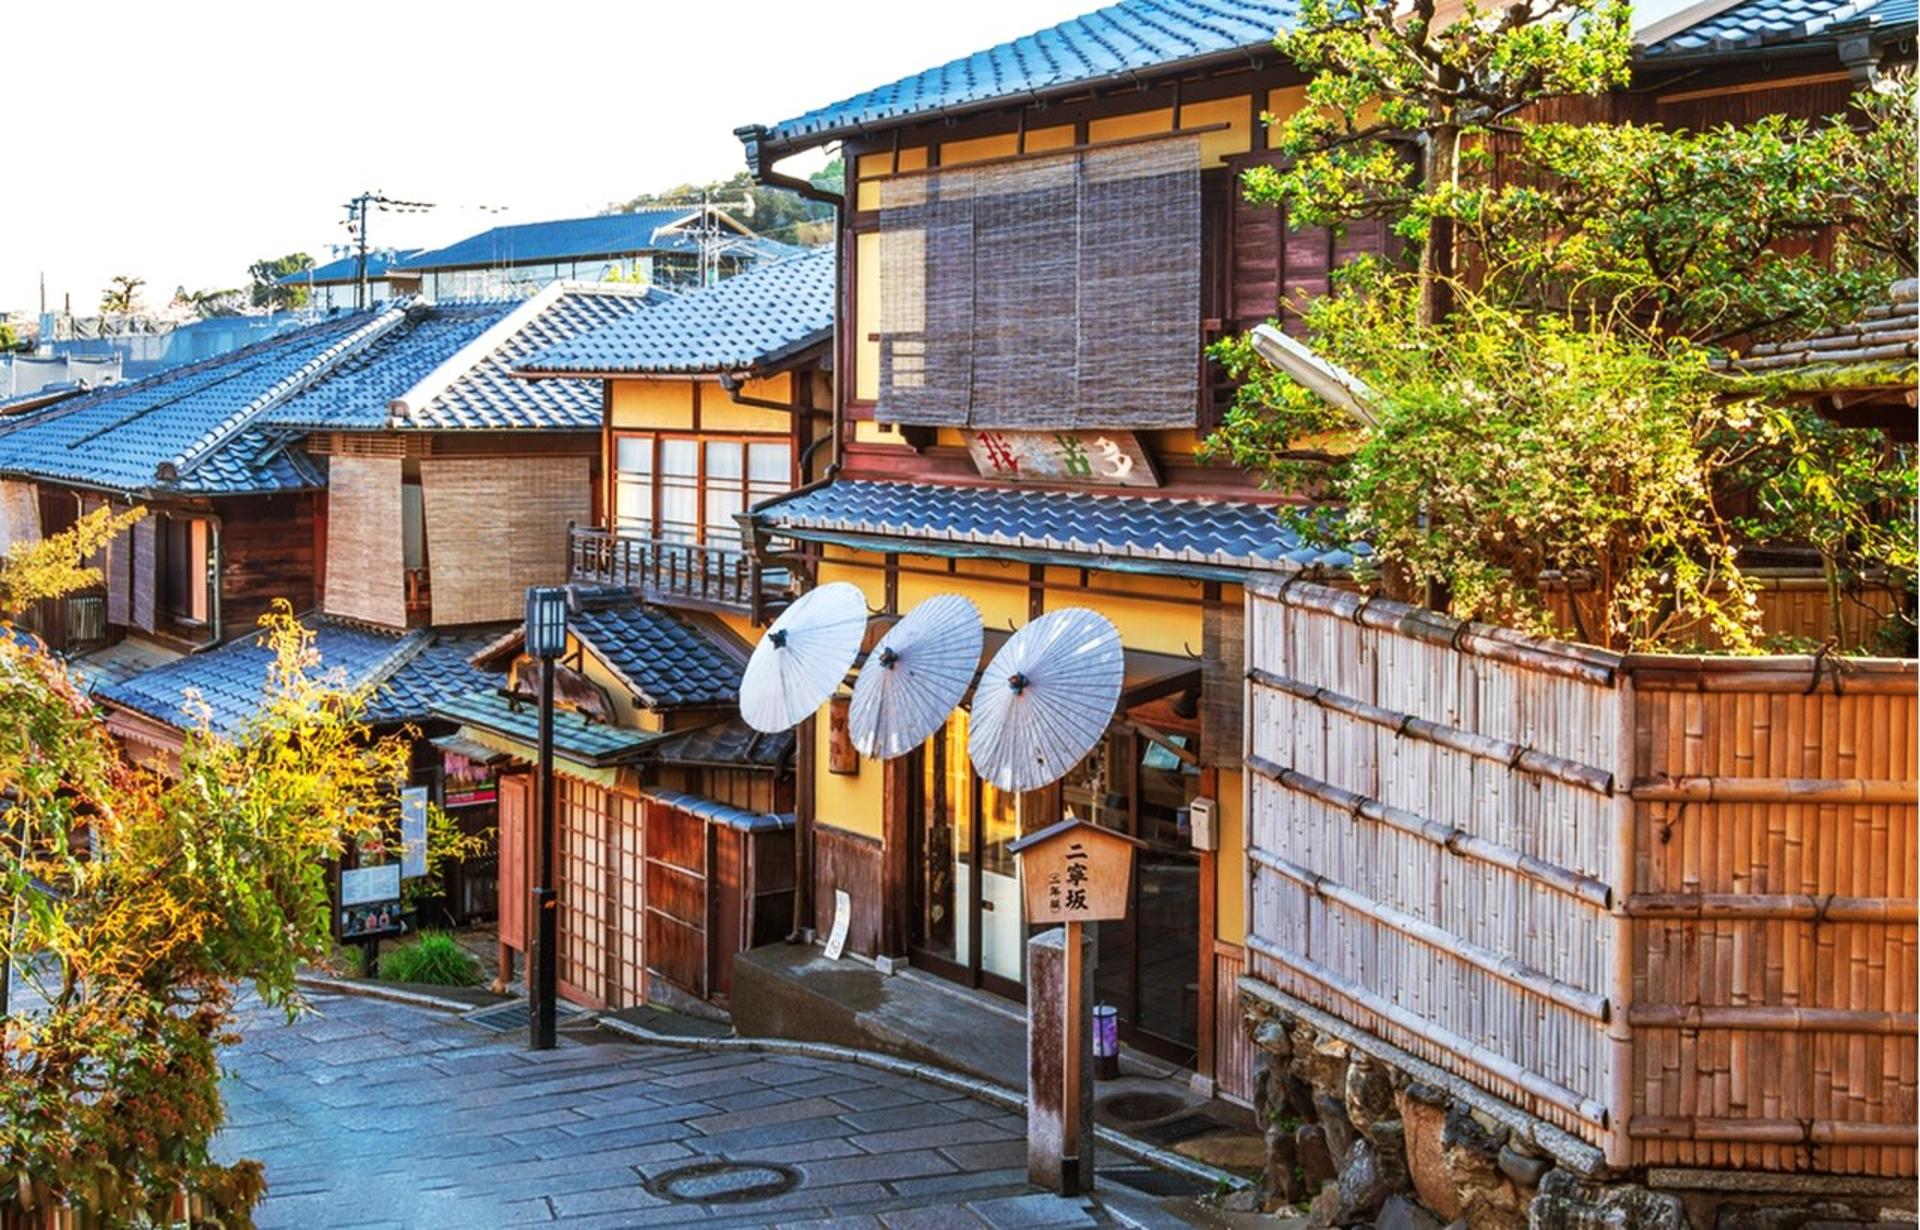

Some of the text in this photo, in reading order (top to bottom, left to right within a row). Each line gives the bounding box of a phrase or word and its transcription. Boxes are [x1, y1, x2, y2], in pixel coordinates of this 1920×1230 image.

[976, 431, 1134, 478] 我苦多
[1065, 844, 1088, 910] 二寧坂
